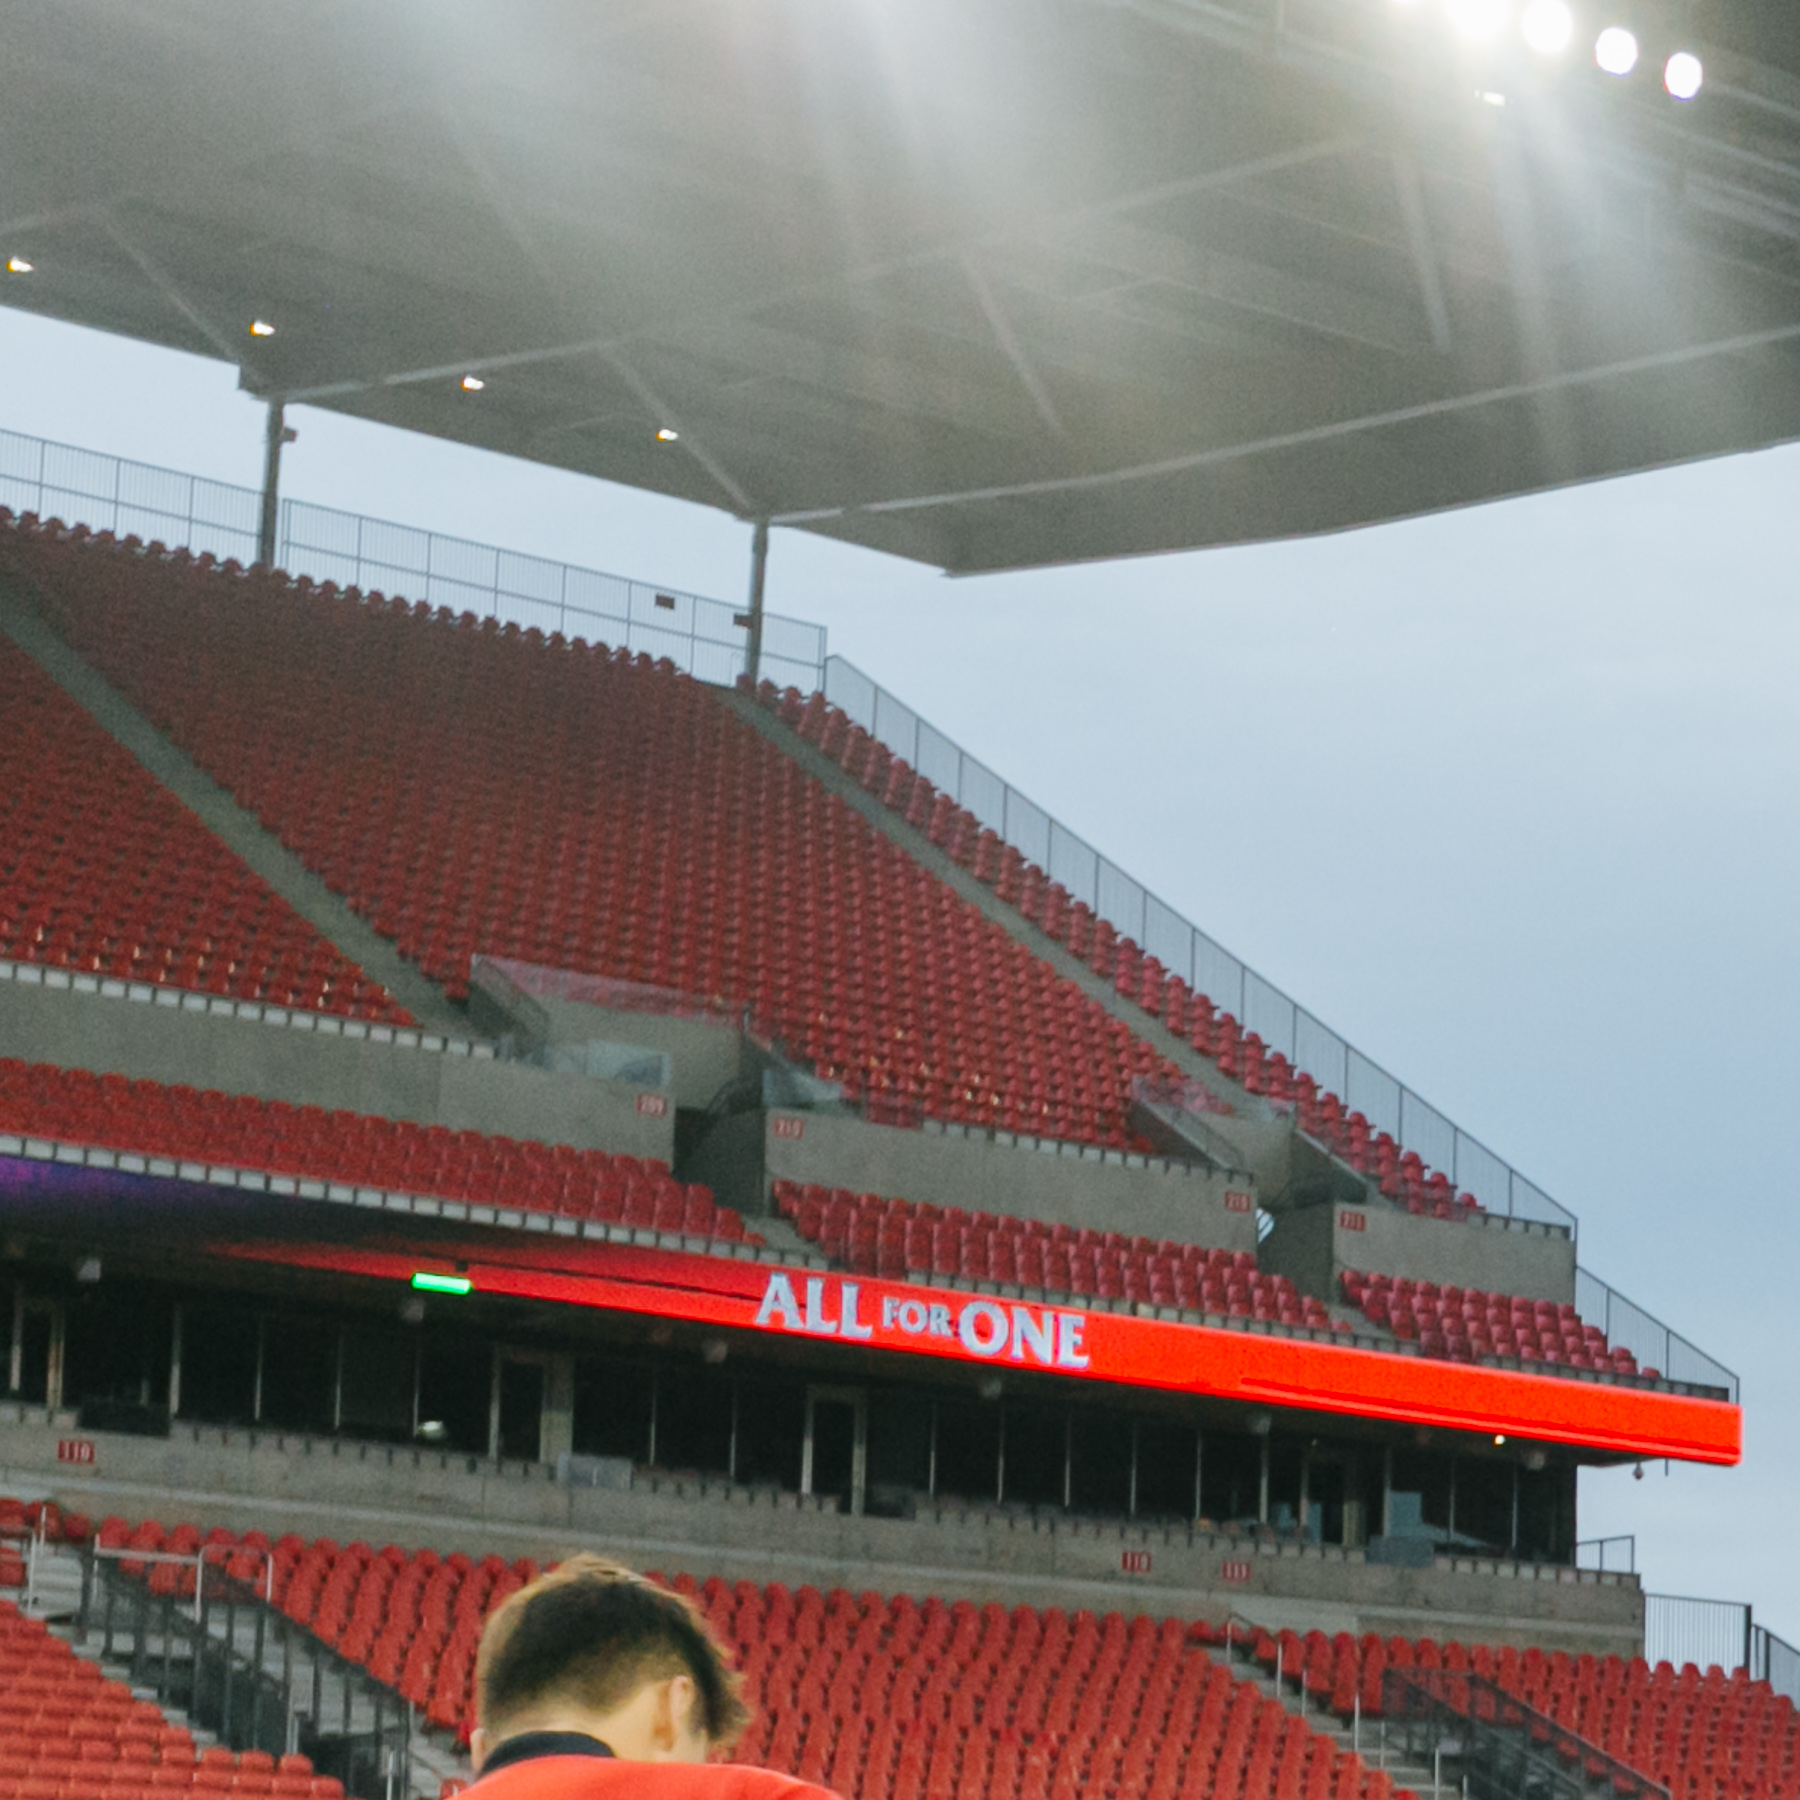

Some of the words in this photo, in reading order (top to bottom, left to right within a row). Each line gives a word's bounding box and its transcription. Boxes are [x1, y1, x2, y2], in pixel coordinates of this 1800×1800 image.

[755, 1271, 874, 1339] ALL
[882, 1296, 953, 1337] FOR
[958, 1300, 1089, 1369] ONE
